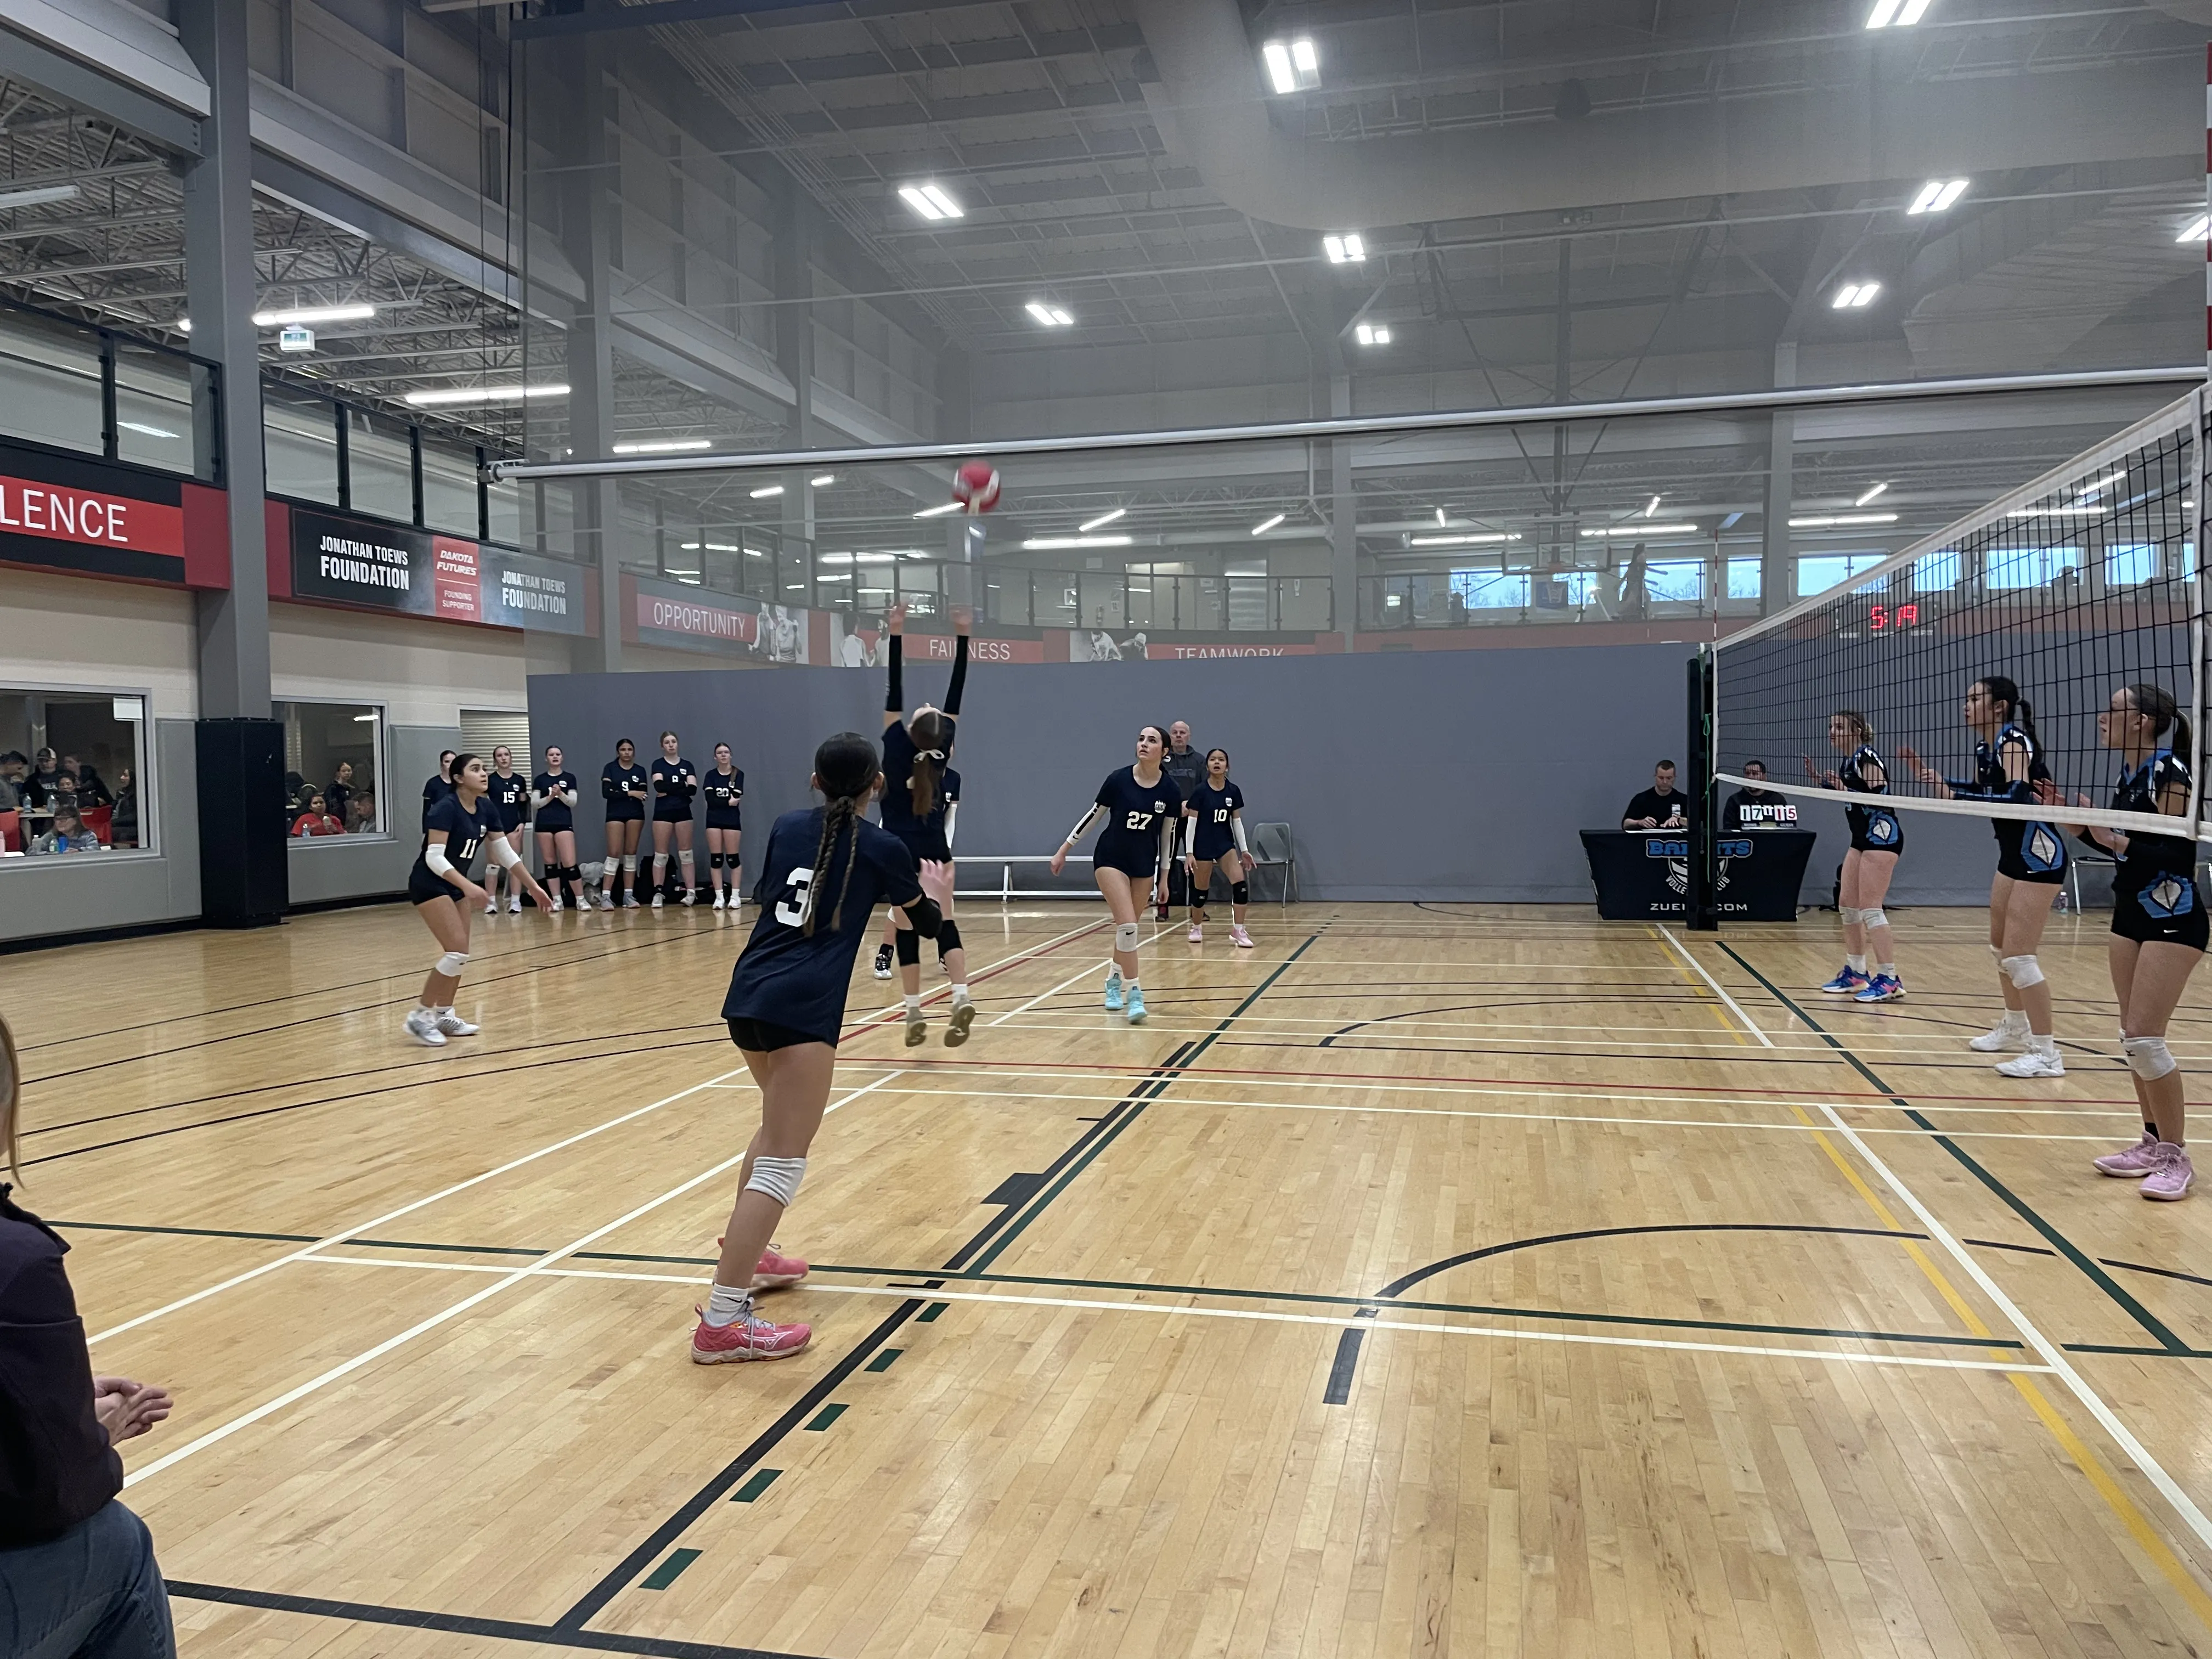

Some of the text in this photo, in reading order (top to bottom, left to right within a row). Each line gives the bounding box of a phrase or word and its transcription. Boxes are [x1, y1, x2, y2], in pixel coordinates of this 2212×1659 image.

[0, 485, 128, 542] LENCE
[320, 535, 408, 565] JONATHAN TOEWS
[441, 550, 473, 563] DAKOTA
[320, 555, 409, 590] FOUNDATION
[437, 562, 476, 576] FUTURES
[502, 571, 566, 594] JONATHAN TOEWS
[444, 590, 472, 601] FOUNDING
[502, 587, 566, 614] FOUNDATION
[442, 601, 474, 611] SUPPORTER
[654, 602, 745, 637] OPPORTUNITY
[1871, 606, 1917, 628] 5:19
[930, 640, 1010, 660] FAINESS
[622, 781, 629, 792] 9
[716, 787, 729, 797] 20
[503, 792, 515, 803] 15
[1126, 811, 1153, 830] 27
[1214, 809, 1227, 823] 10
[1743, 808, 1761, 820] 17
[1778, 808, 1796, 820] 15
[460, 839, 477, 859] 11
[775, 867, 814, 927] 3
